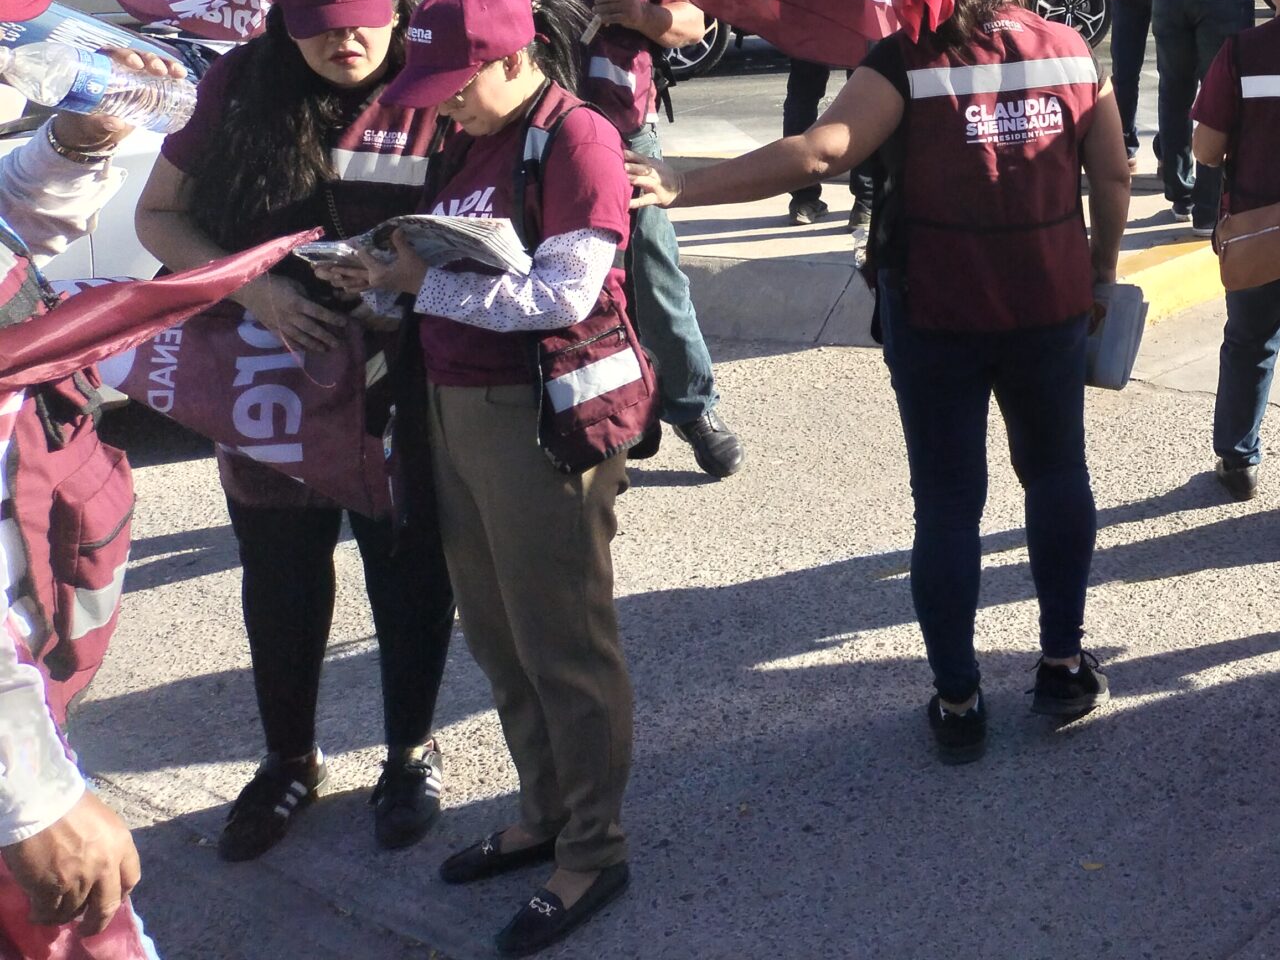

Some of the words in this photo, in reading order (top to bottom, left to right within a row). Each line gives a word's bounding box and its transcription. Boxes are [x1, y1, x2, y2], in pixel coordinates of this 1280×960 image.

[965, 97, 1062, 122] CLAUDIA
[966, 113, 1062, 136] SHEINBAUM
[364, 129, 408, 140] CLAUDIA
[987, 131, 1045, 143] PRESIDENTA
